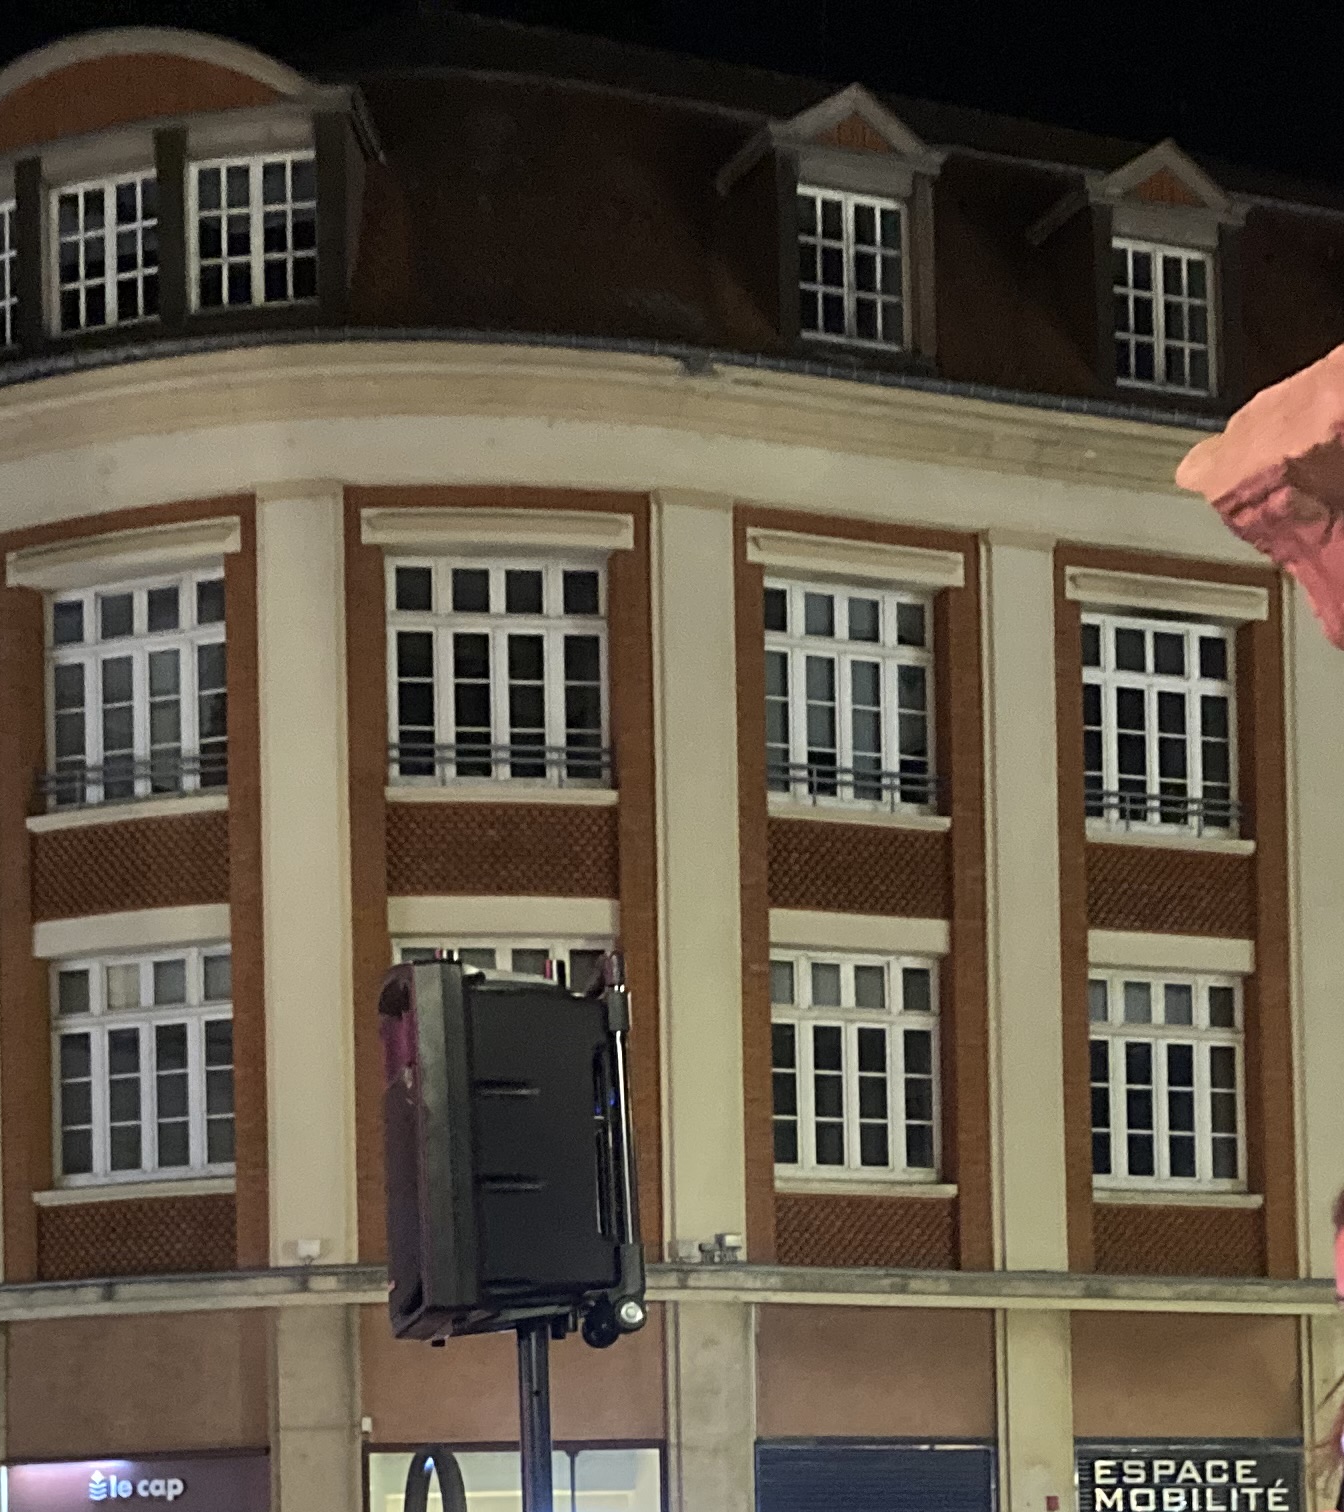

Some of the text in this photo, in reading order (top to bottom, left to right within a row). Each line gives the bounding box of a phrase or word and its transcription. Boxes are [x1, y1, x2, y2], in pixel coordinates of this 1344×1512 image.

[1093, 1459, 1258, 1484] ESPACE
[109, 1474, 185, 1502] le cap
[1094, 1478, 1290, 1512] MOBILITÉ
